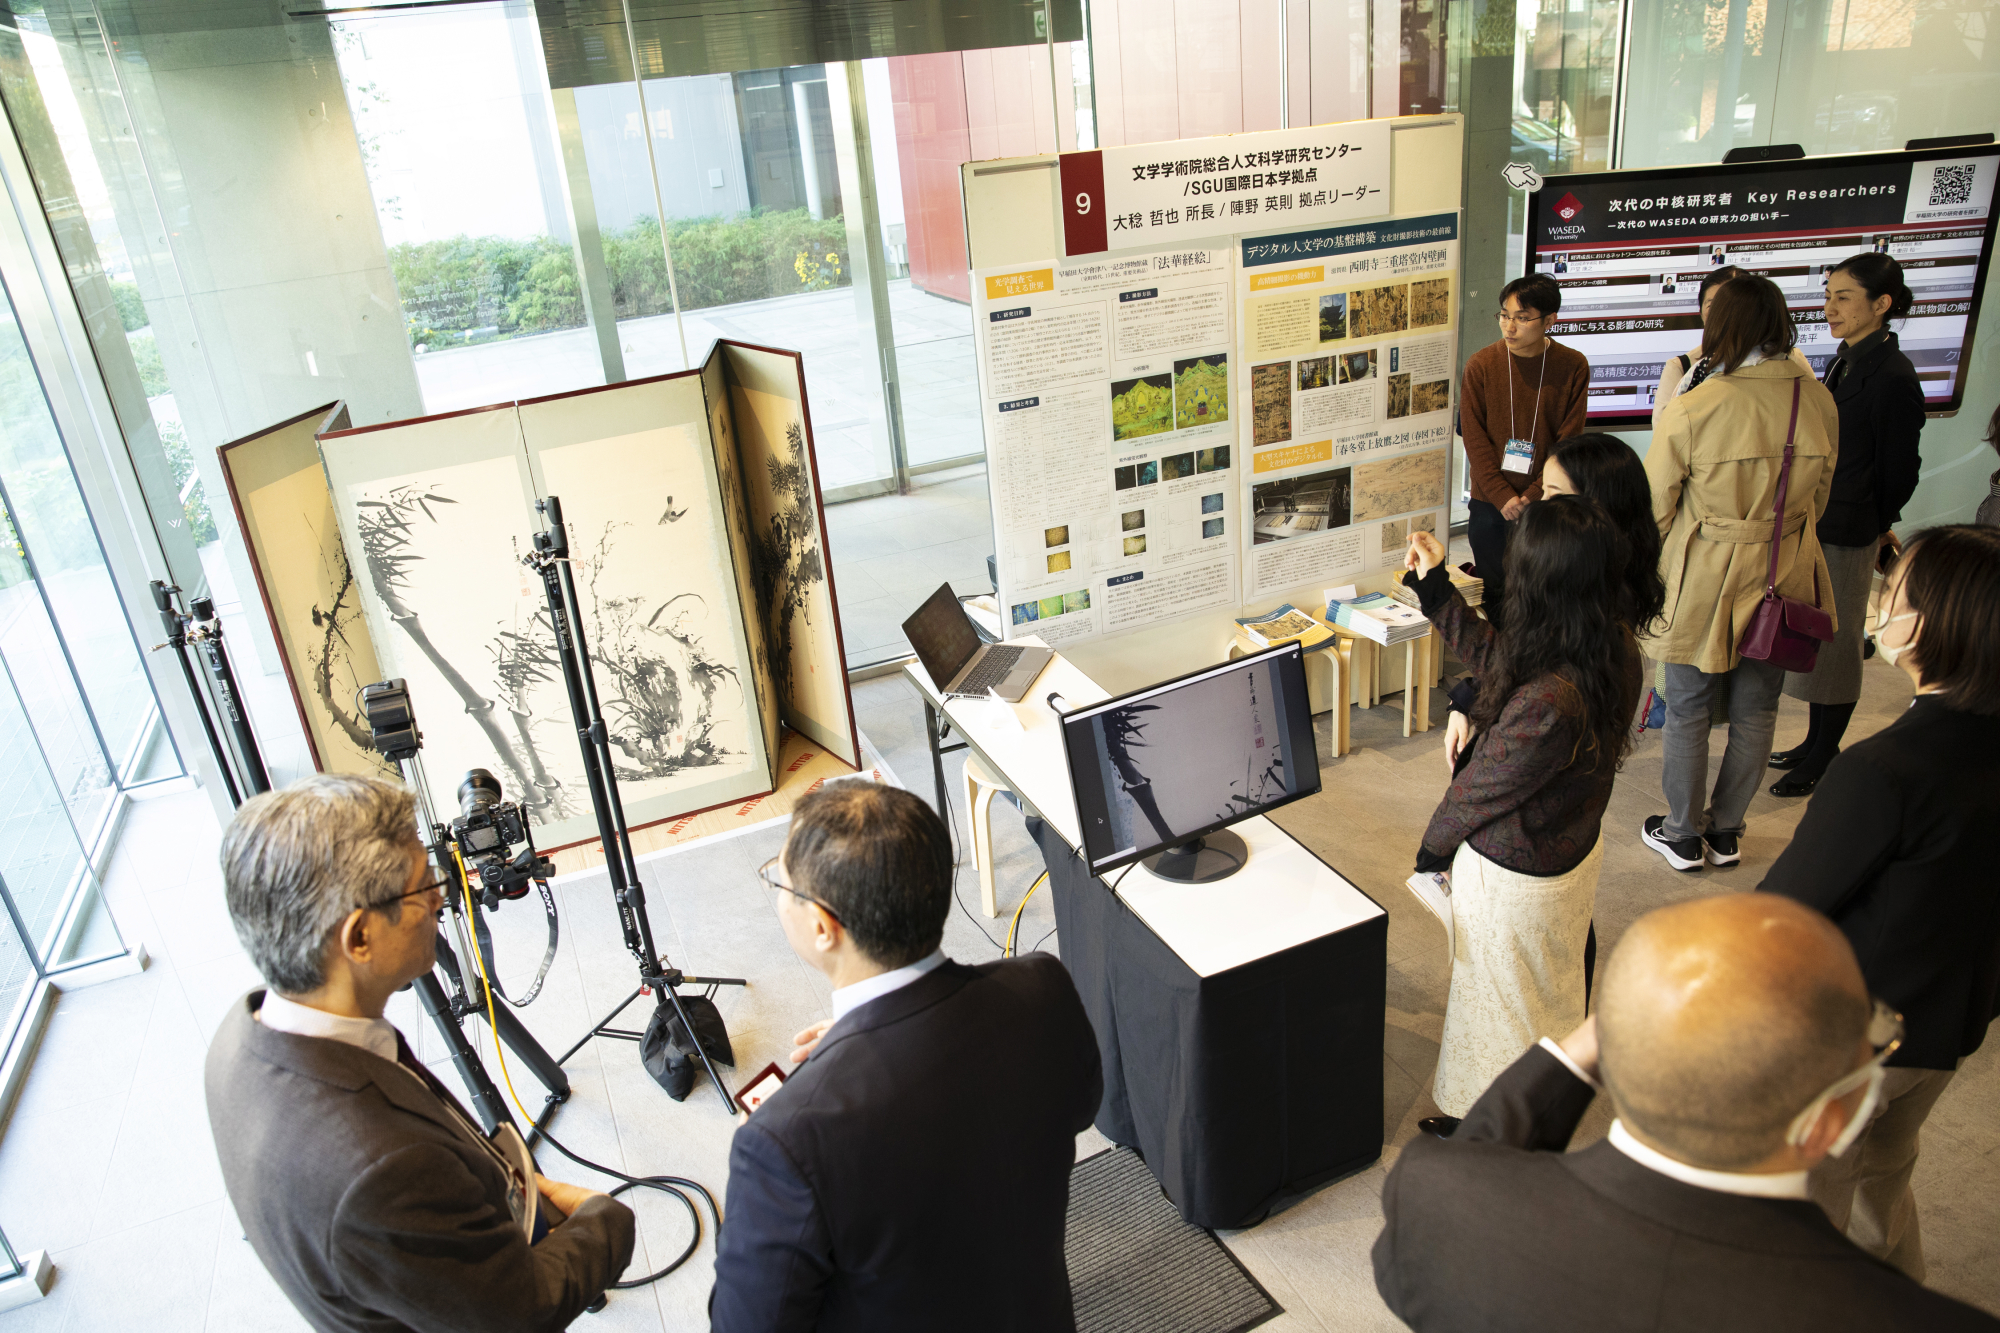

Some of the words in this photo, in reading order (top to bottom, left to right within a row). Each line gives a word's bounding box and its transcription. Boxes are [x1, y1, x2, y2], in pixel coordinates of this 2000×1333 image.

[1132, 143, 1362, 182] 文学学術院総合人文科学研究センター
[1183, 167, 1318, 197] /SGU国際日本学拠点
[1075, 192, 1092, 215] 9
[1113, 213, 1143, 232] 大稔
[1150, 208, 1179, 227] 哲也
[1185, 203, 1215, 223] 所長
[1230, 198, 1259, 217] 陣野
[1264, 193, 1293, 212] 英則
[1299, 185, 1381, 209] 拠点リーダー
[1608, 192, 1733, 213] 次代の中核研究者
[1747, 192, 1779, 205] Key
[1786, 184, 1897, 202] Researchers
[1548, 225, 1586, 235] WASEDA
[1649, 217, 1698, 228] WASEDA
[1247, 230, 1377, 260] デジタル人文学の基盤構築
[1379, 226, 1452, 244] 文化財撮影技術の最前線
[1553, 233, 1579, 241] University
[1152, 251, 1211, 270] 「法華経絵」
[1349, 248, 1447, 274] 西明寺三重塔堂内壁画
[995, 274, 1034, 288] 光学調査で
[1006, 281, 1045, 295] 見える世界
[1556, 279, 1608, 288] メージセンサーの開発
[1545, 319, 1665, 335] 知行動に与える影響の研究
[786, 752, 814, 772] NITTSU
[539, 884, 556, 917] SONY
[622, 906, 633, 931] NANLITE
